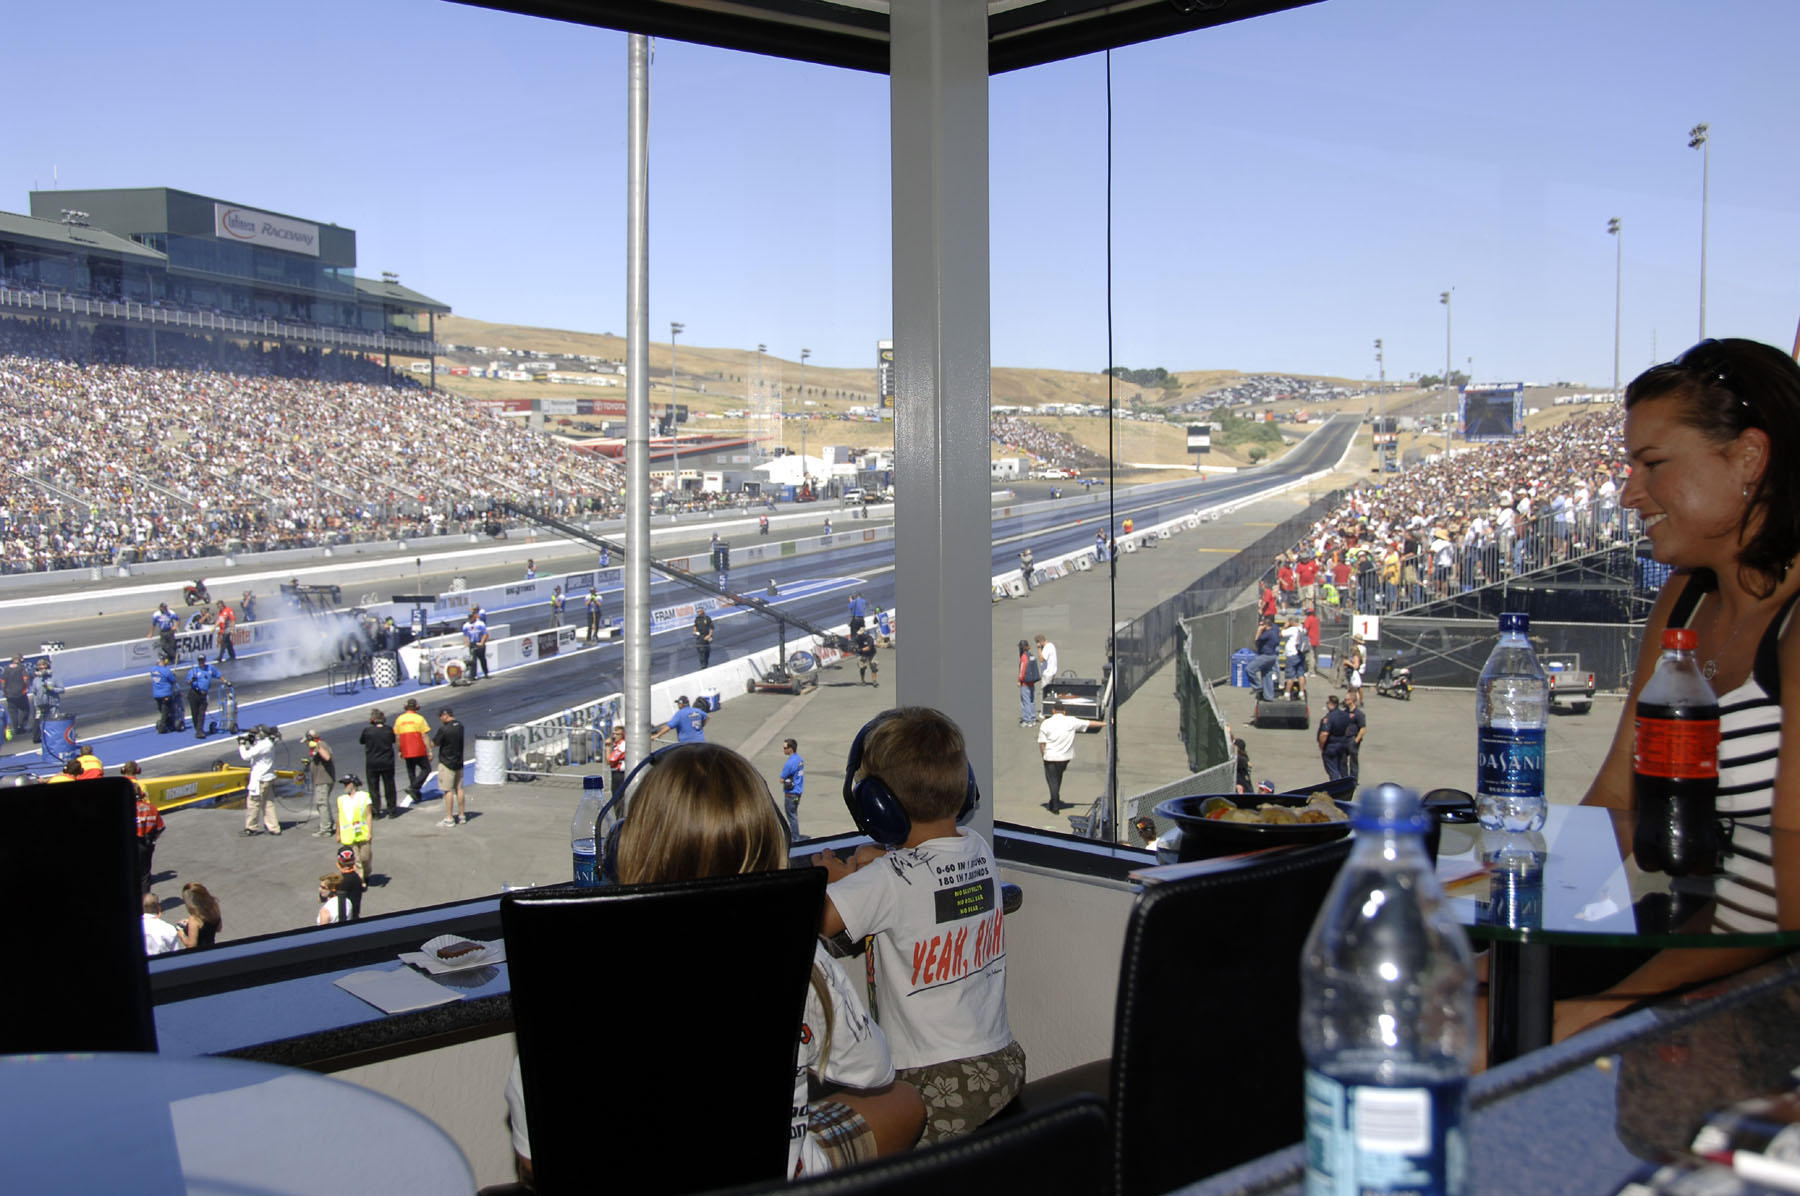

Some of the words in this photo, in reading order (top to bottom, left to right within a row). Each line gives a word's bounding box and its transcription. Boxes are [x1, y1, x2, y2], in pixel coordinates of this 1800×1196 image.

[654, 608, 676, 622] FRAM
[1363, 621, 1368, 634] 1
[174, 634, 213, 653] FRAM
[1479, 752, 1540, 772] DASANI
[936, 863, 955, 875] 0-60
[957, 861, 966, 871] IN
[938, 876, 955, 887] 180
[956, 873, 964, 883] IN
[911, 925, 968, 986] YEAH,
